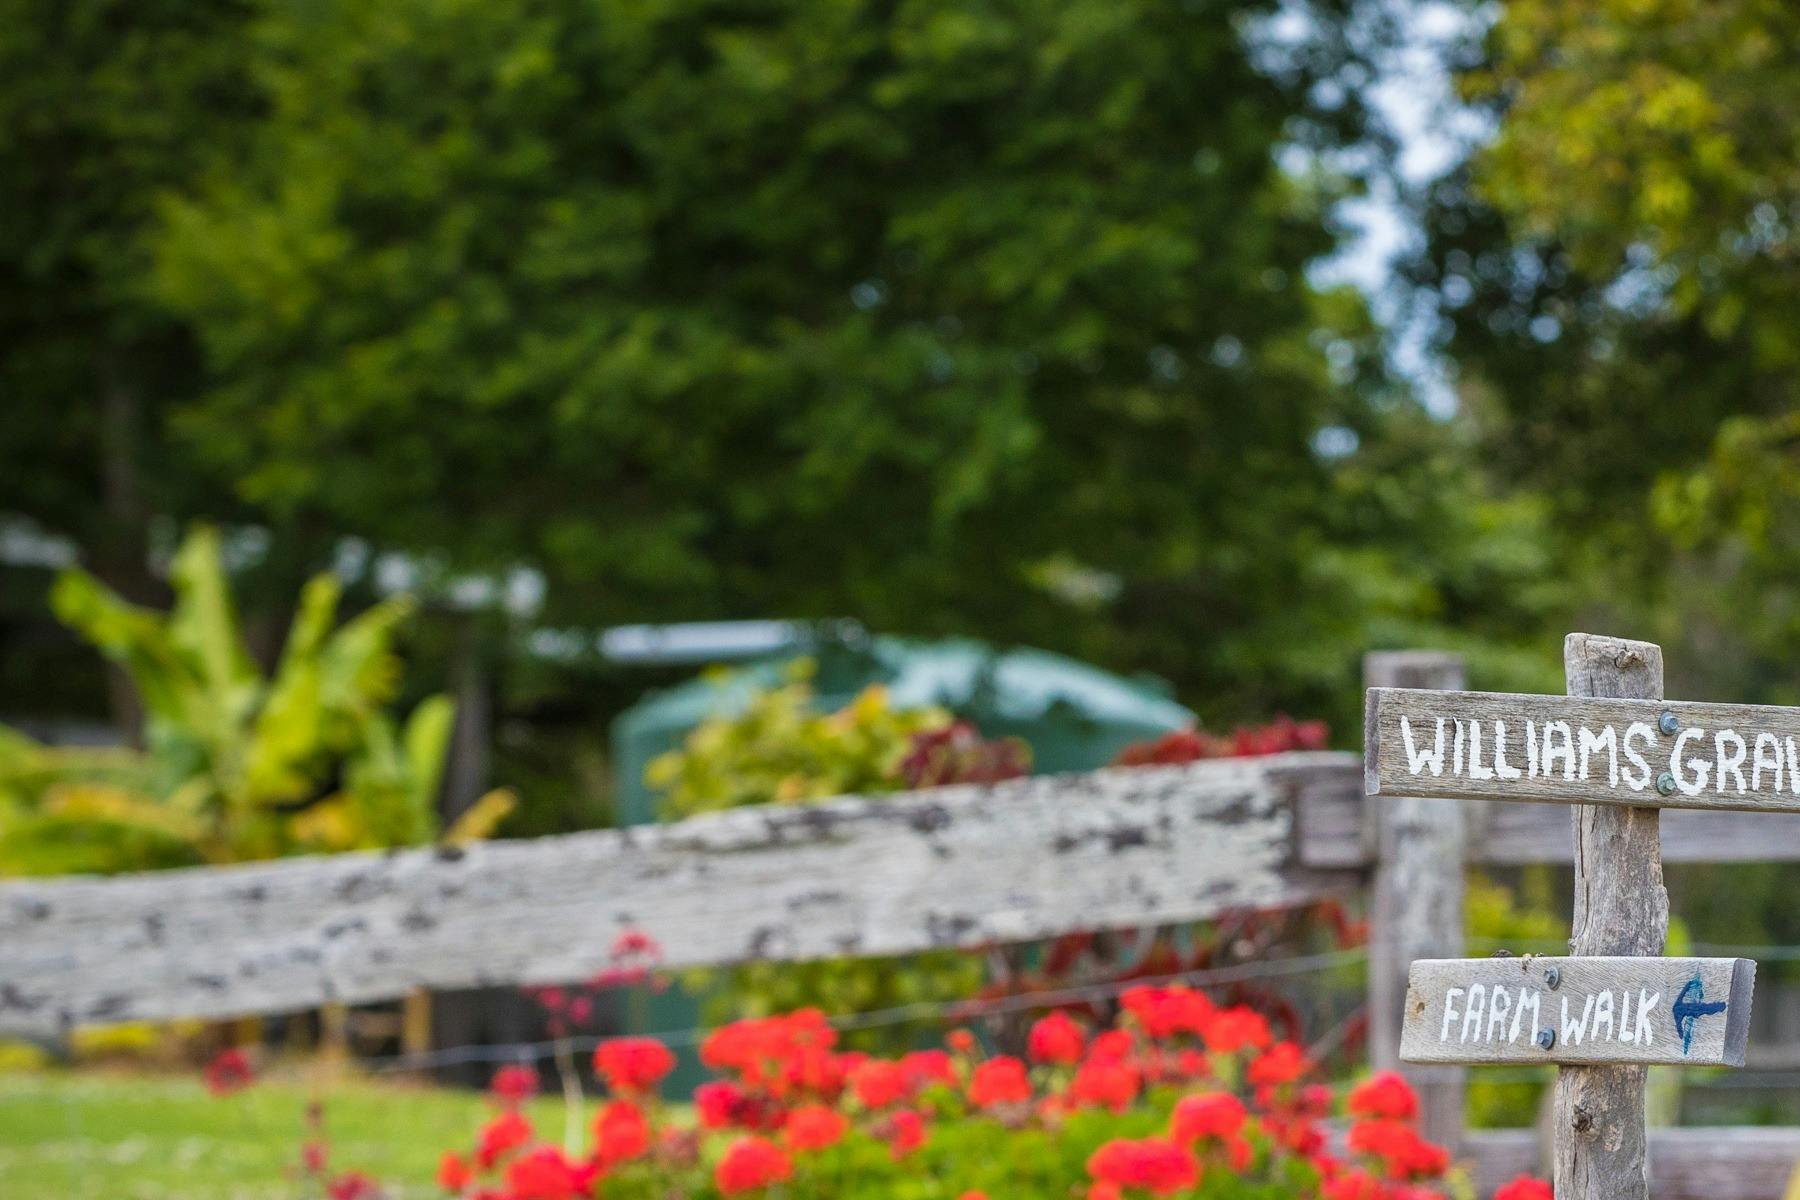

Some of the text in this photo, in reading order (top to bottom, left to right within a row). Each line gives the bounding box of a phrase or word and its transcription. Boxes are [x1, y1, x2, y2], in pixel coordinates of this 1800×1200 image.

[1400, 715, 1660, 791] WILLIAMS
[1440, 983, 1660, 1047] FARM WALK
